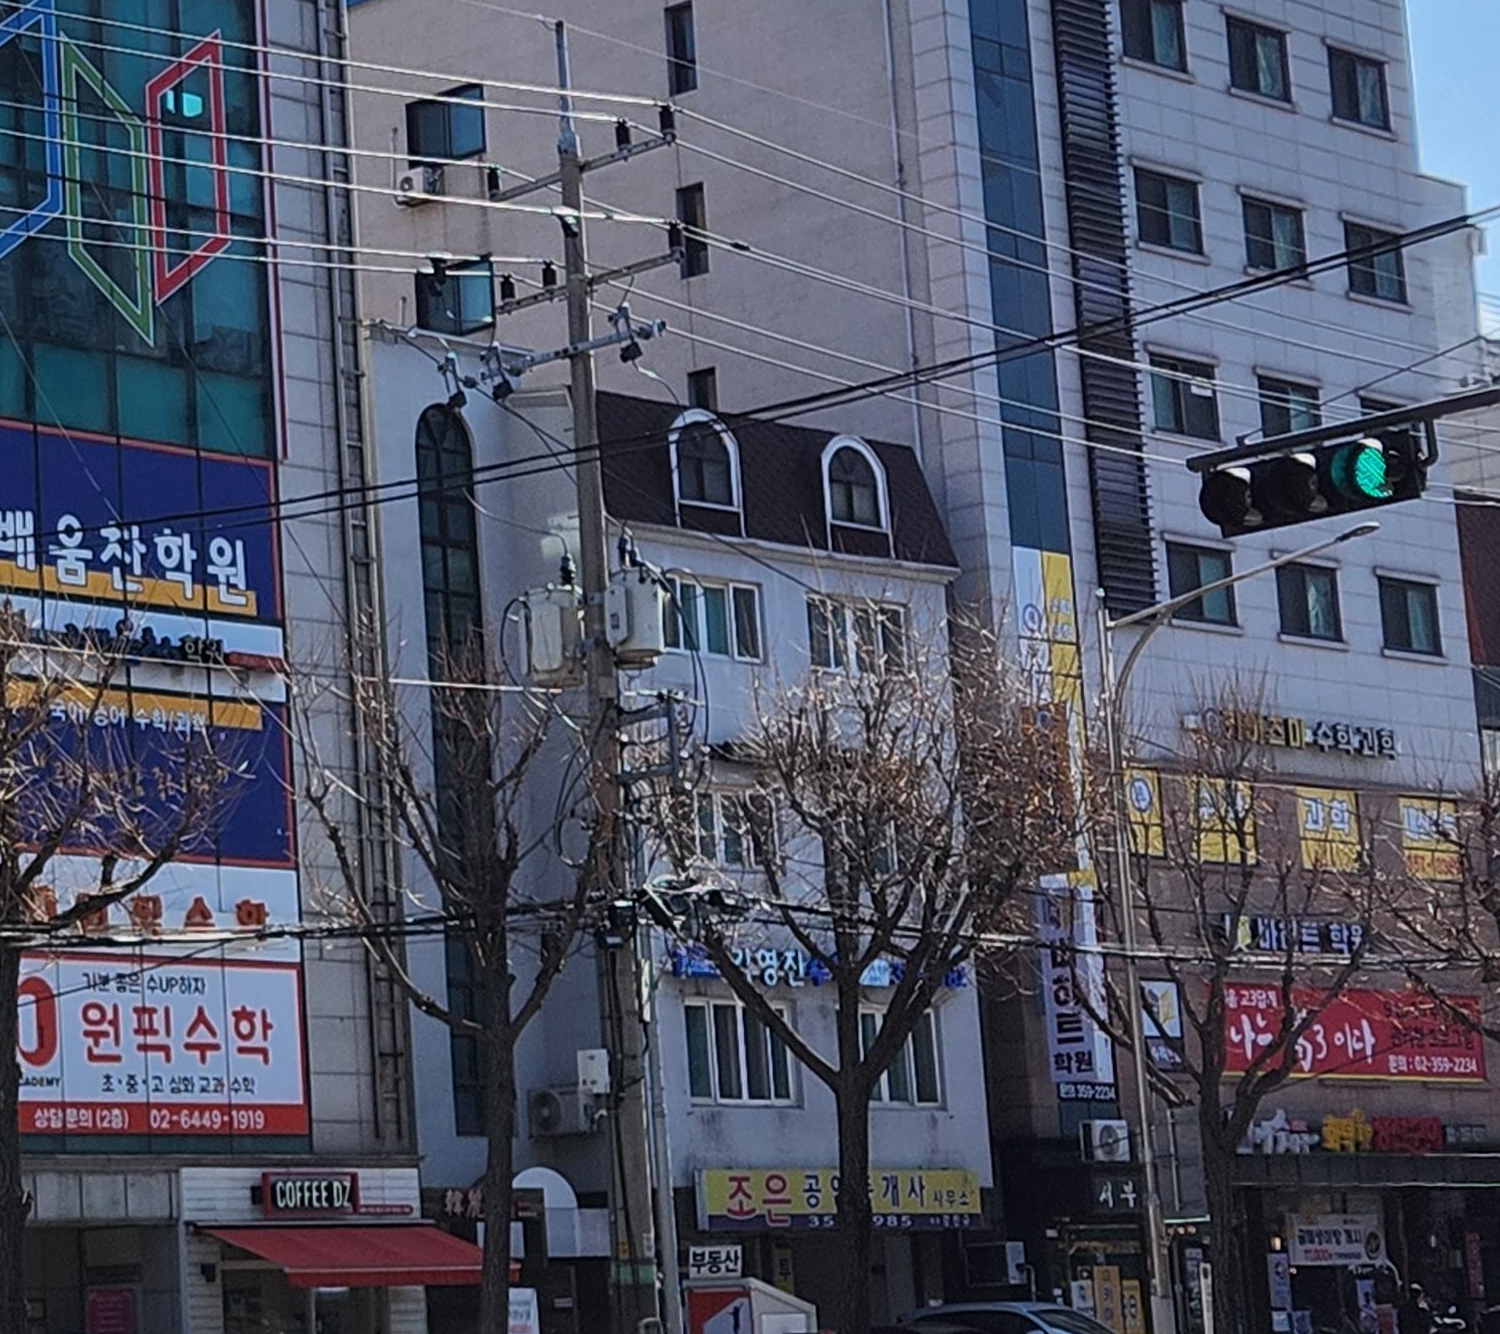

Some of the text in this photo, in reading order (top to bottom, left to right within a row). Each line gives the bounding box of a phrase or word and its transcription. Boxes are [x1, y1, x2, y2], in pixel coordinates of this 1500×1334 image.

[80, 1001, 274, 1067] 원픽수학
[1053, 1050, 1094, 1074] 학원
[150, 1108, 266, 1131] 02-6449-1919
[275, 1180, 329, 1209] COFFEE
[727, 1173, 792, 1227] 조은
[802, 1173, 926, 1209] 공개사
[690, 1248, 741, 1275] 부동산
